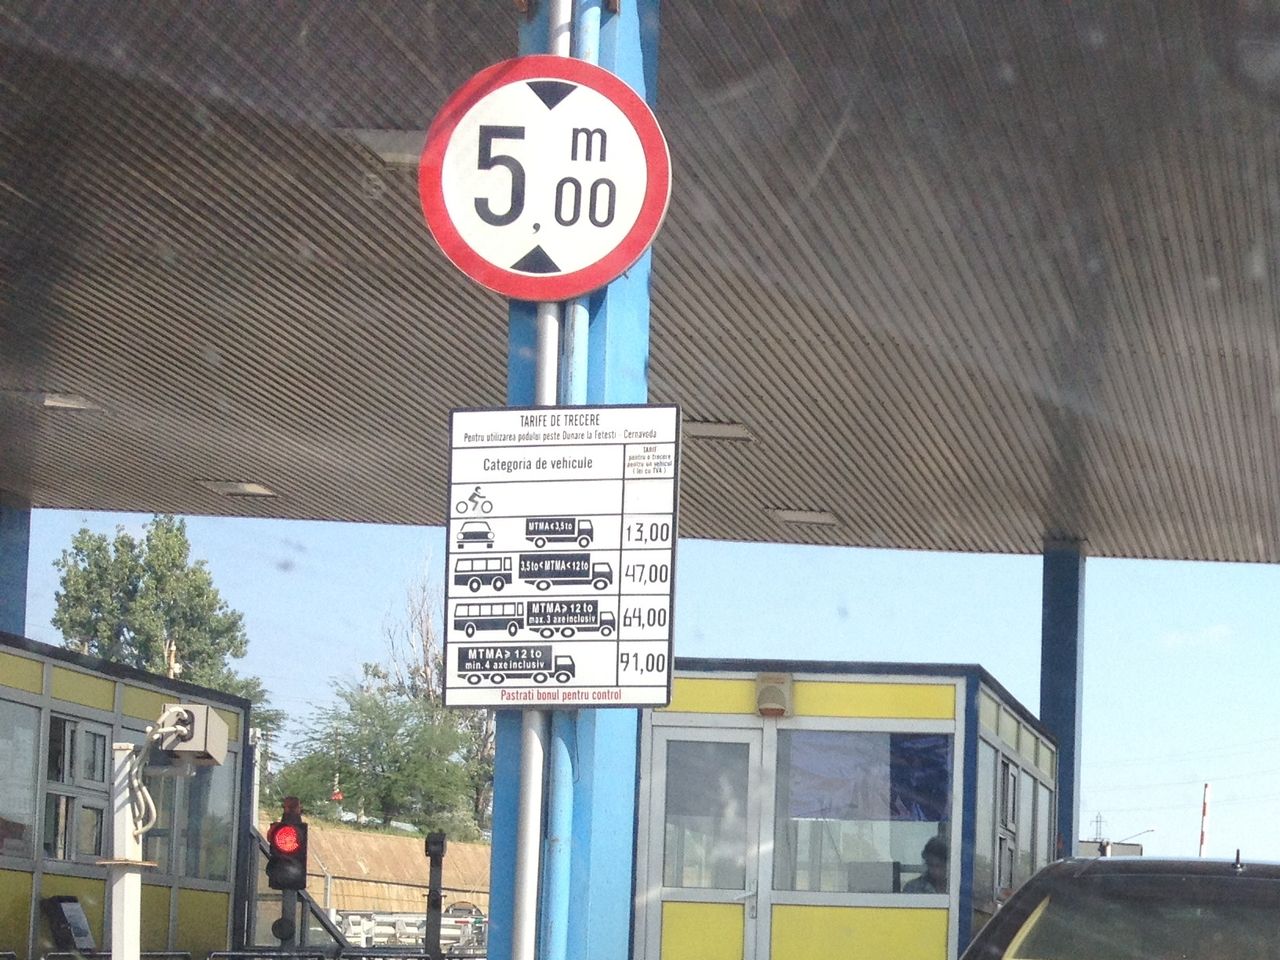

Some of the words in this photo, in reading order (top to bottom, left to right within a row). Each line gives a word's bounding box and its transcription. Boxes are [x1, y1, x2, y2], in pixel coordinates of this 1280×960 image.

[571, 127, 607, 162] m
[520, 415, 547, 427] TARIFE
[550, 414, 560, 426] DE
[564, 413, 600, 426] TRECERE
[464, 432, 484, 442] Pentru
[486, 432, 516, 442] utilizarea
[543, 431, 560, 442] peste
[562, 430, 585, 440] Dunare
[586, 430, 592, 439] la
[594, 429, 617, 439] Fetesti
[483, 457, 532, 473] Categoria
[535, 457, 547, 470] de
[550, 456, 593, 469] vehicule
[626, 522, 670, 544] 13,00
[625, 564, 668, 586] 47,00
[570, 603, 581, 613] 12
[583, 602, 593, 613] to
[623, 607, 667, 630] 64,00
[514, 649, 527, 659] 12
[530, 648, 542, 658] to
[465, 660, 484, 669] min.
[484, 660, 490, 669] 4
[620, 652, 665, 675] 91,00
[500, 689, 534, 701] Pastrati
[536, 689, 560, 701] bonul
[562, 689, 589, 702] pentru
[592, 689, 622, 700] control
